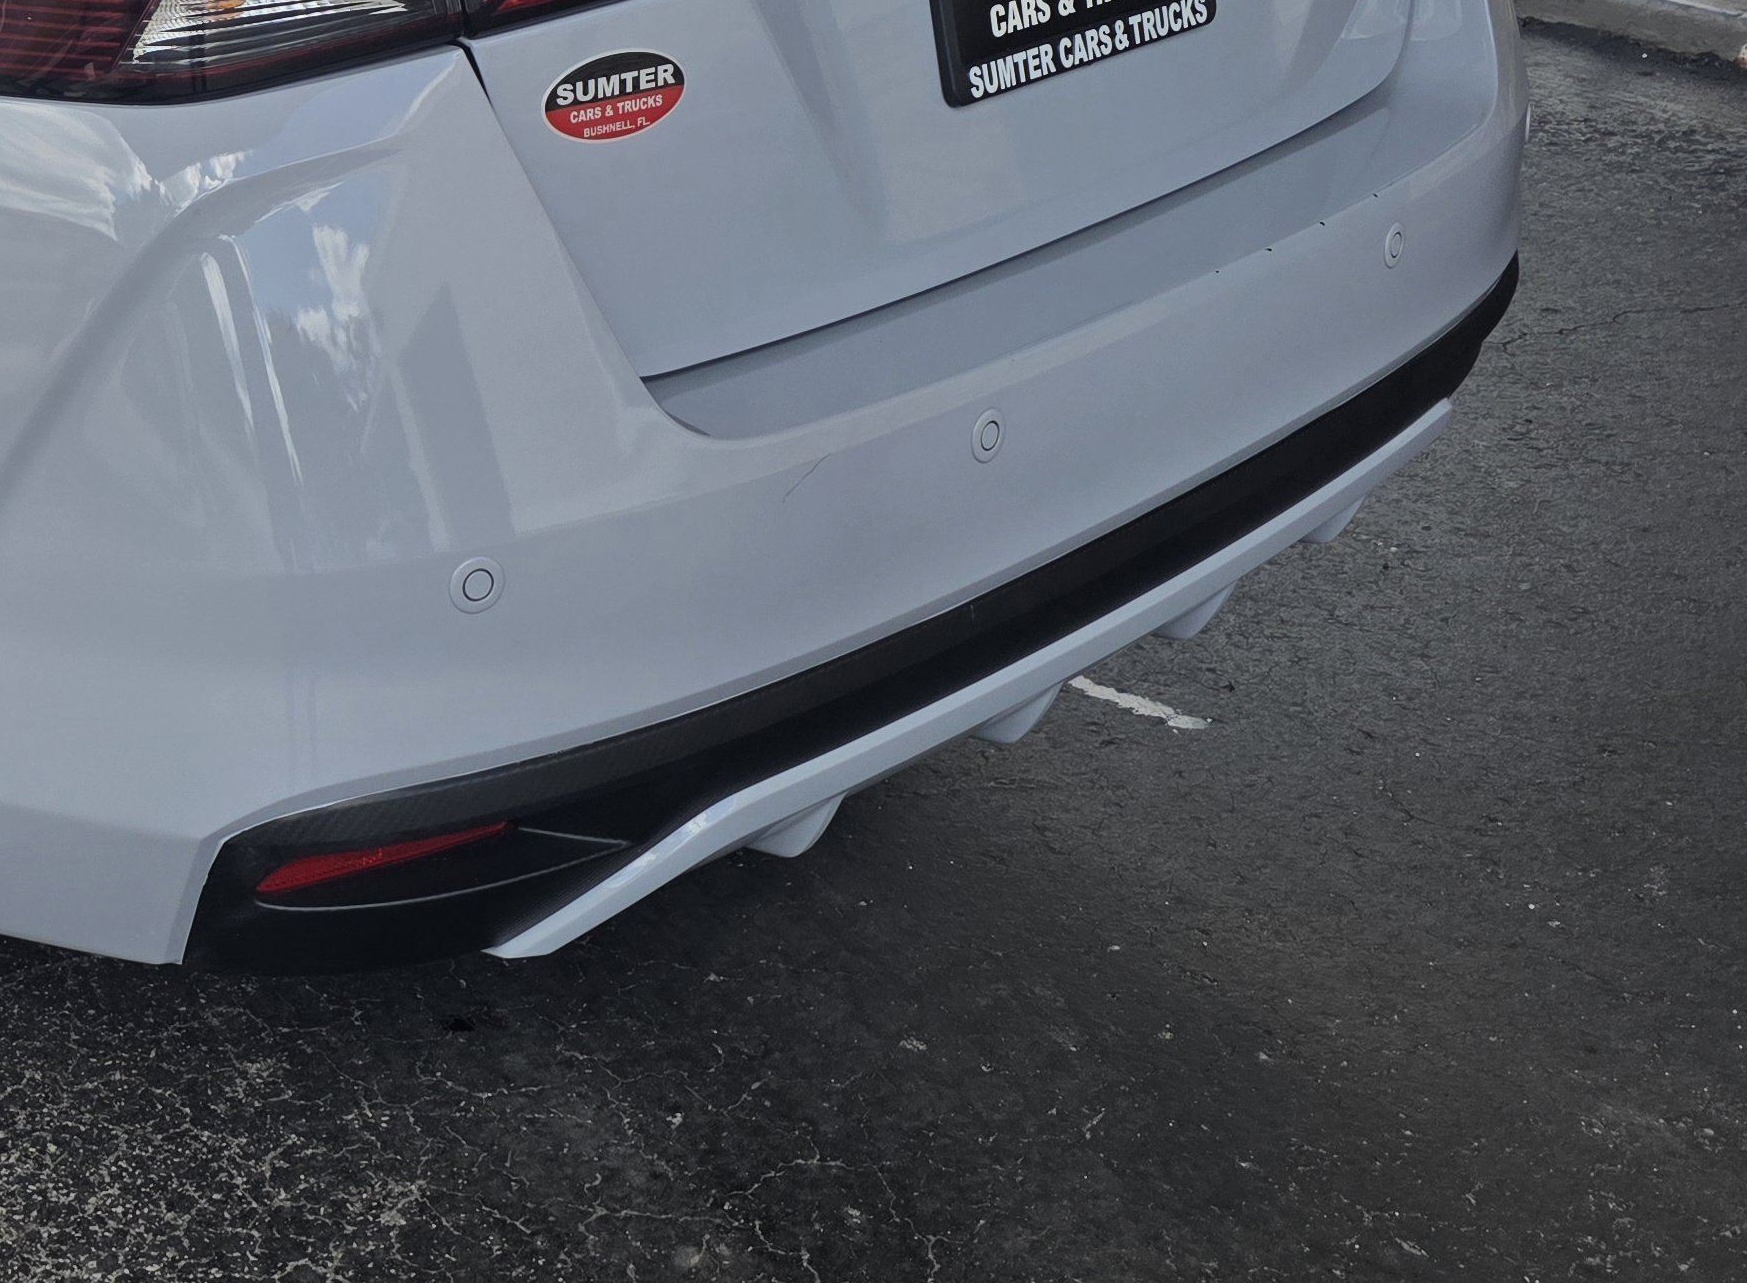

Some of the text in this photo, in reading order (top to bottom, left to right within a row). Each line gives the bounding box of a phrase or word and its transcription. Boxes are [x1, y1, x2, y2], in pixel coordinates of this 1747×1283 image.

[968, 43, 1057, 99] SUMTER
[1059, 23, 1113, 69] CARS
[1114, 19, 1129, 51] &
[556, 63, 676, 106] SUMTER
[569, 94, 663, 124] CARS & TRUCKS
[583, 120, 635, 138] BUSHNELL,
